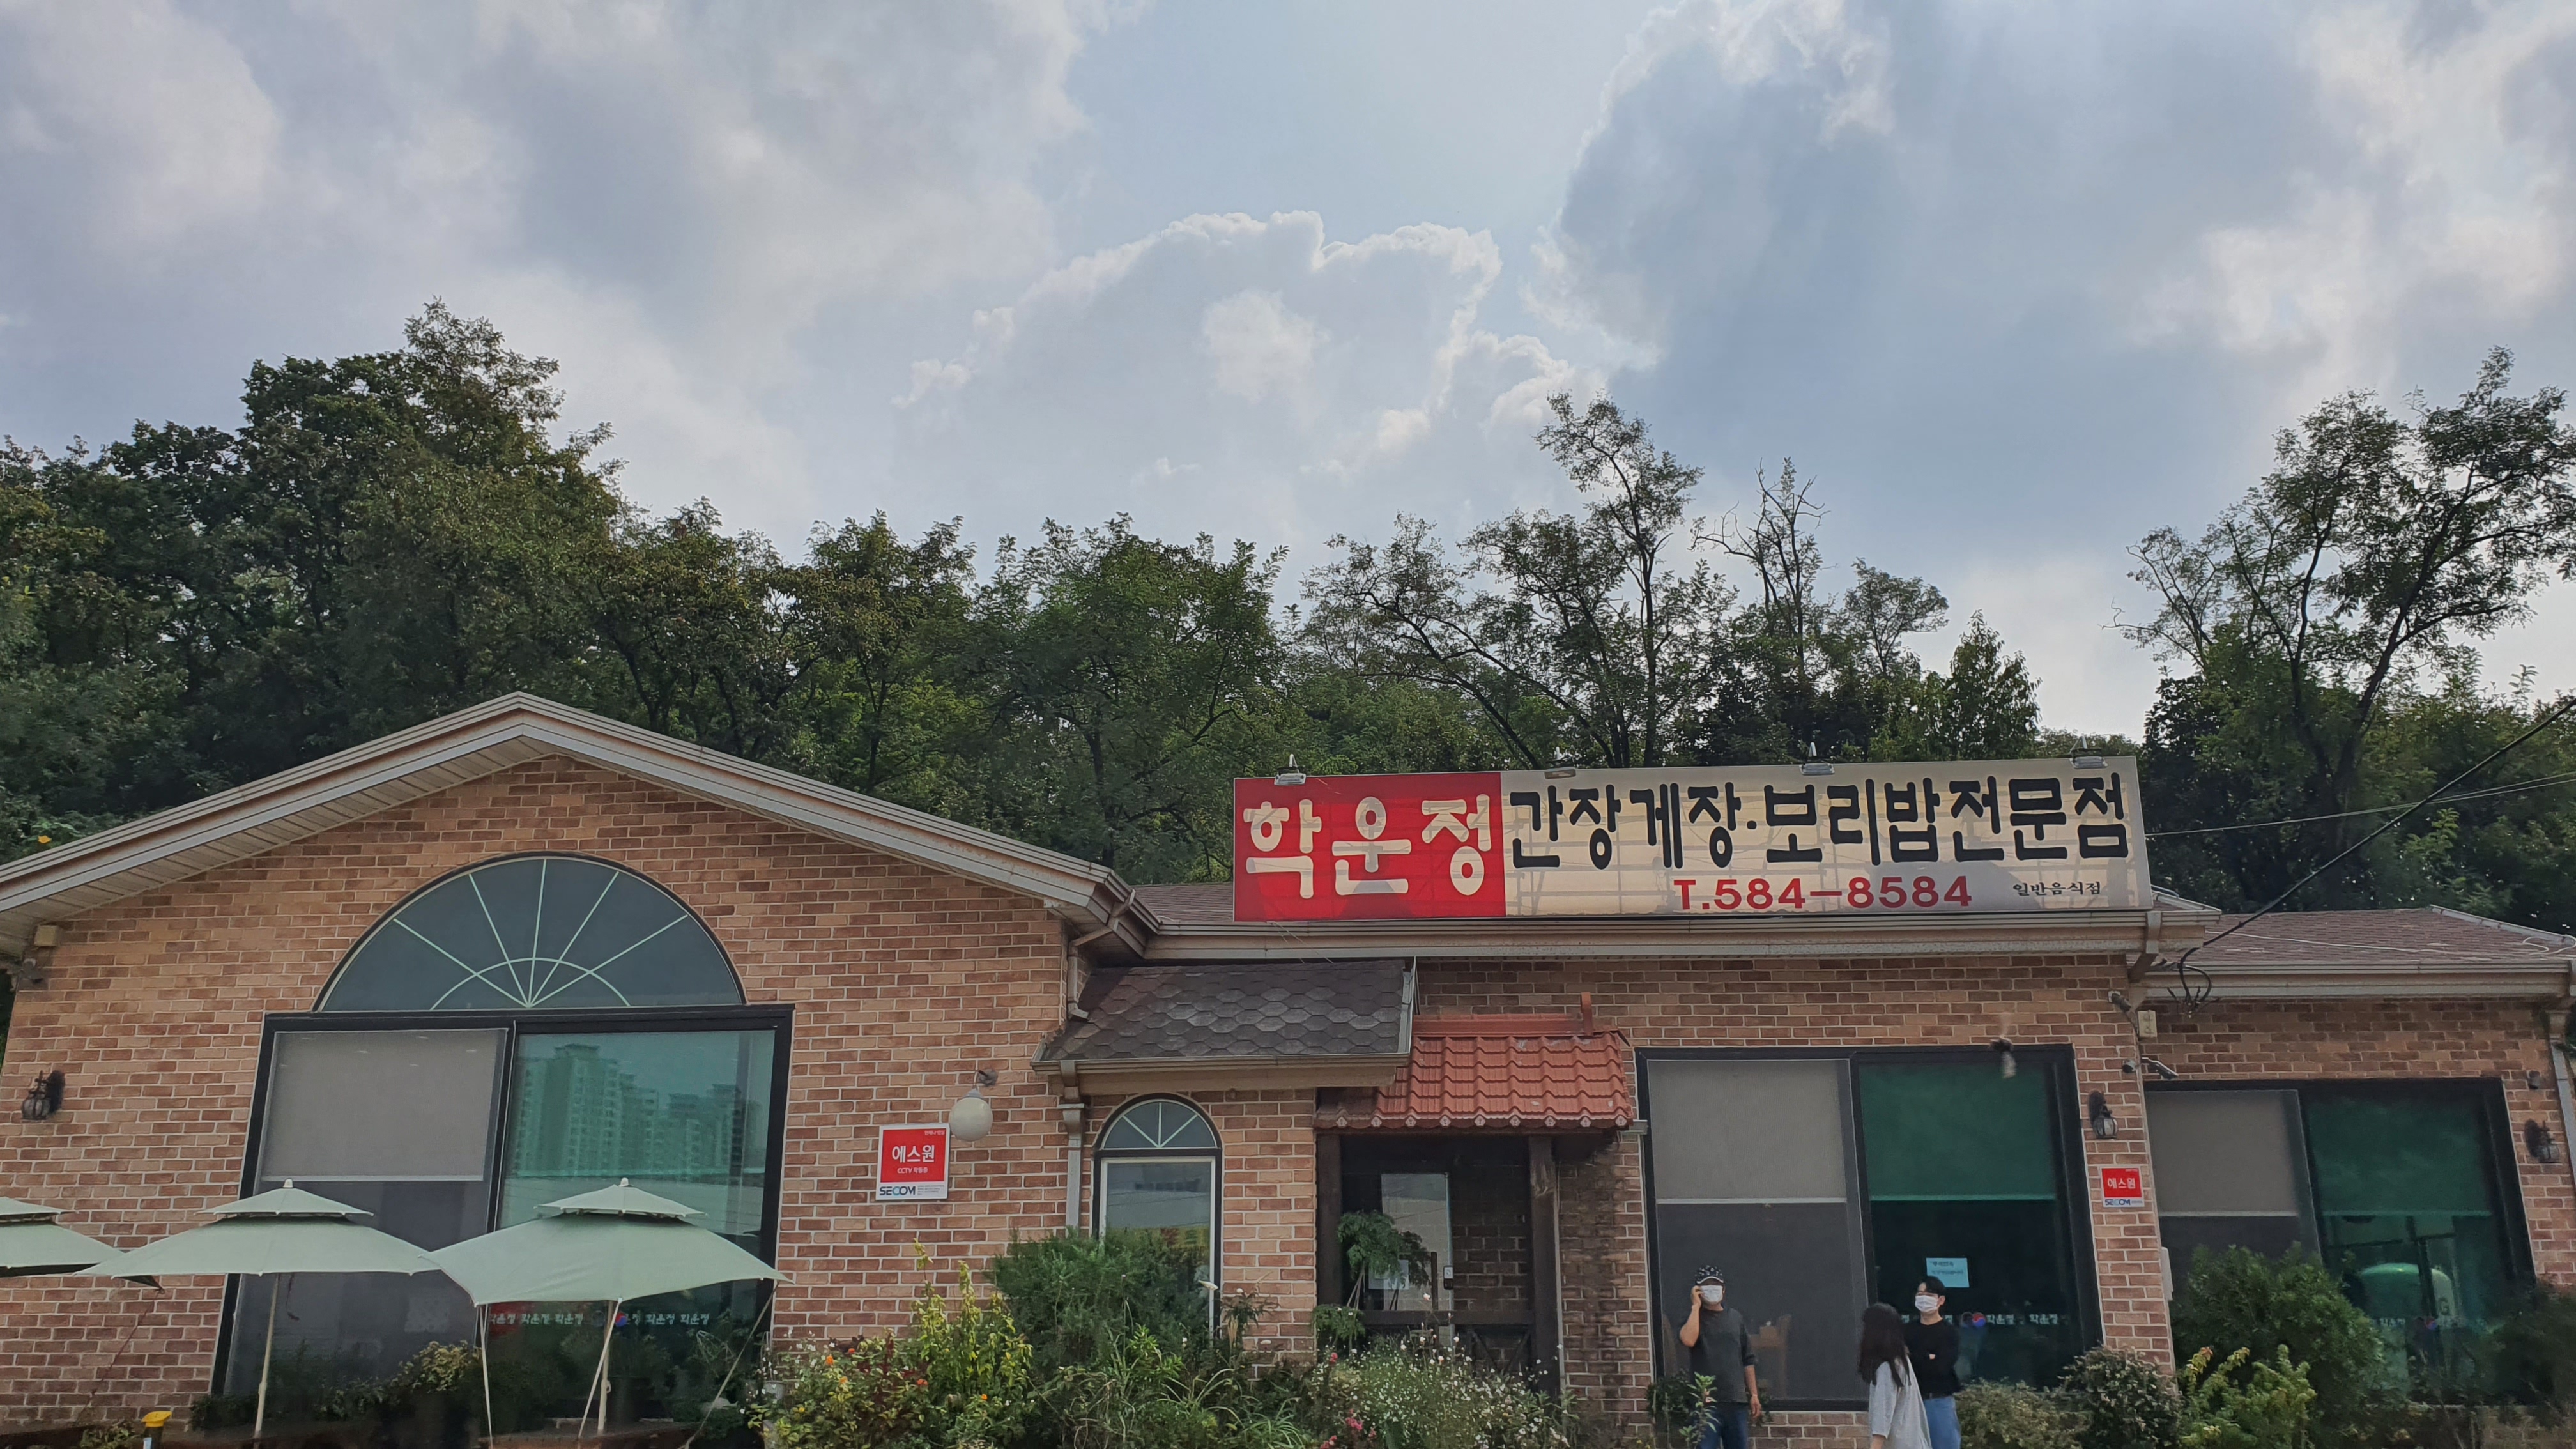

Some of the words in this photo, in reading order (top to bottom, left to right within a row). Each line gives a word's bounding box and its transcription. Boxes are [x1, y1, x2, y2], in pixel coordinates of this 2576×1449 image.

[1243, 794, 1492, 900] 학운정
[2012, 881, 2101, 896] 일반음식점
[892, 1144, 935, 1163] 에스원
[2107, 1177, 2136, 1189] 에스원
[879, 1186, 916, 1196] SECOM
[645, 1314, 675, 1325] 학운정
[680, 1314, 709, 1325] 학운정
